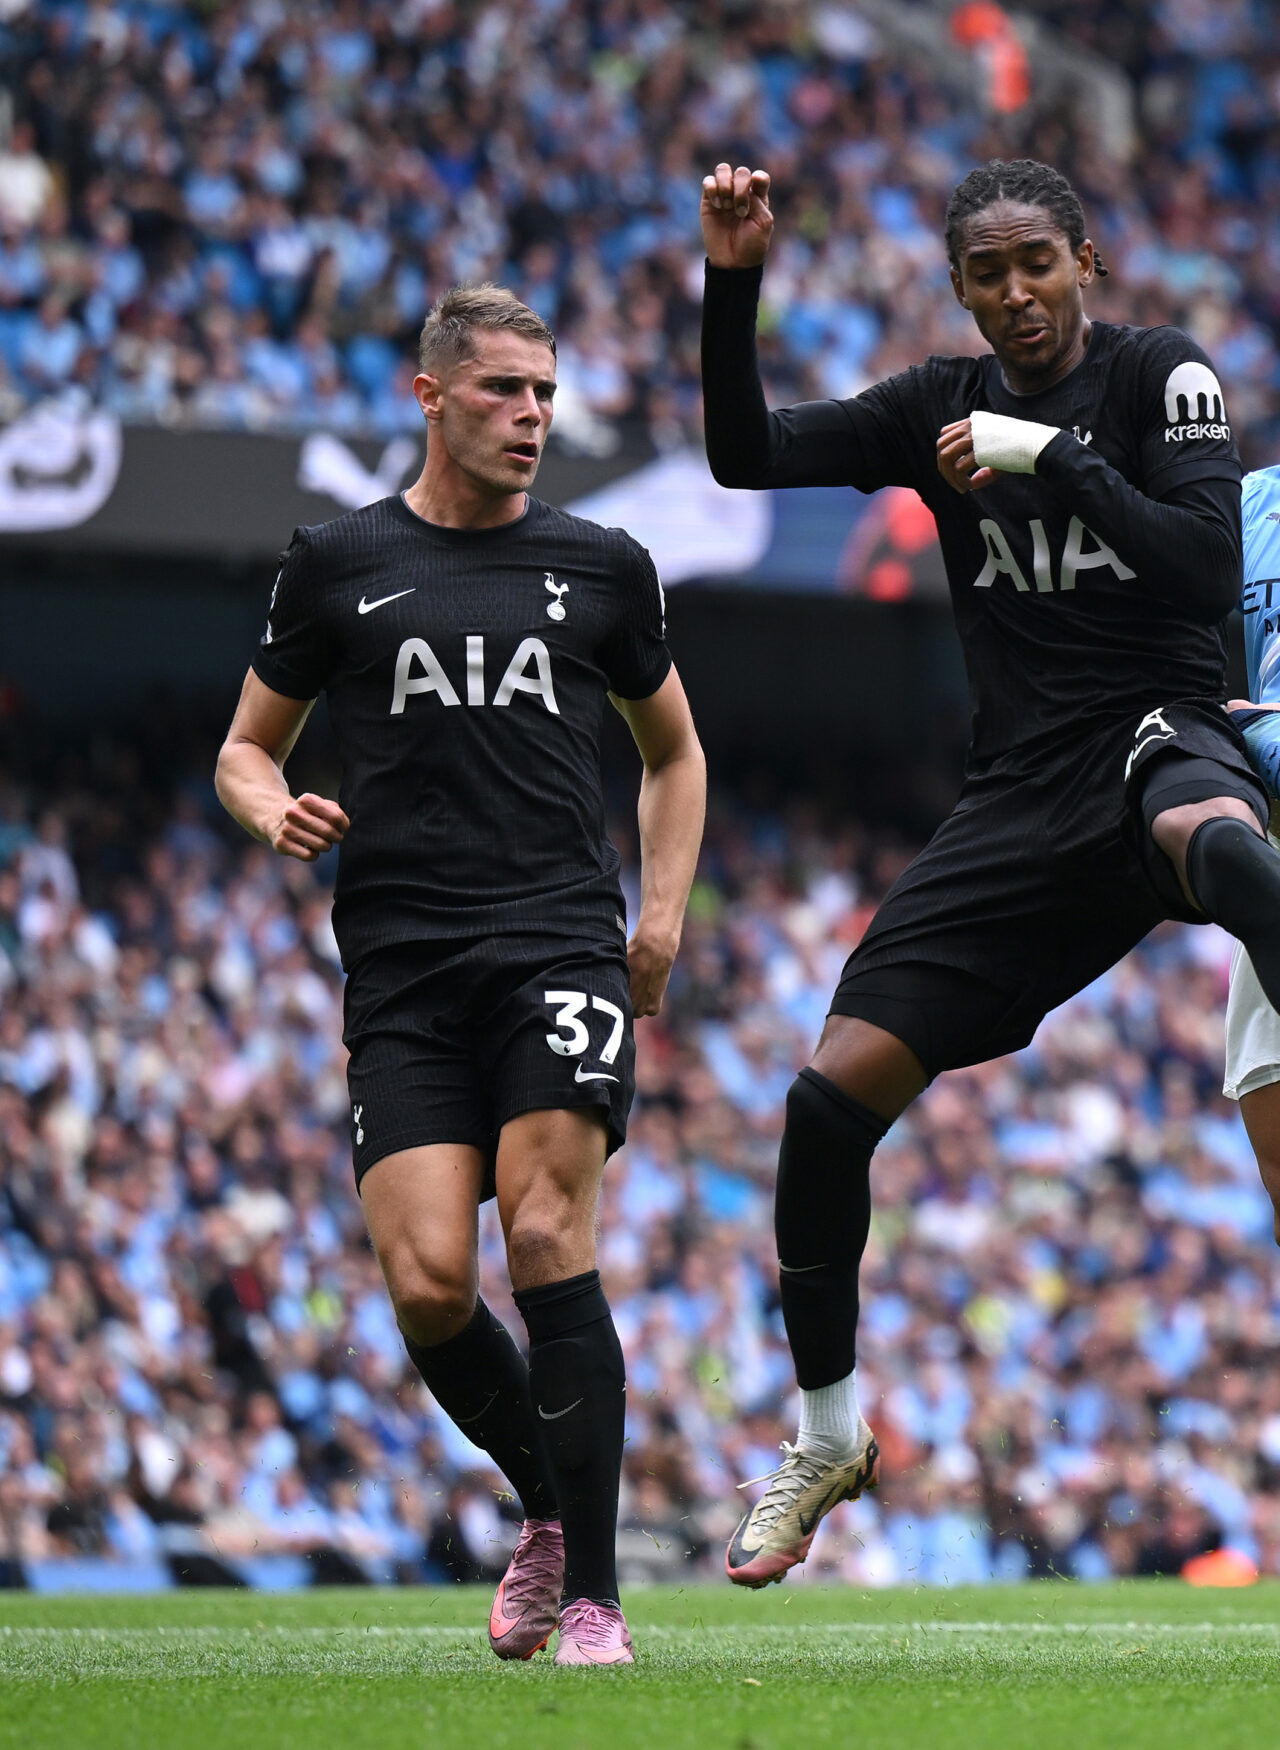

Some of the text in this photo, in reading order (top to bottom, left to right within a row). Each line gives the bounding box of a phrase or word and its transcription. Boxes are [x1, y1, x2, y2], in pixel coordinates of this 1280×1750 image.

[1164, 423, 1231, 443] kraken
[973, 514, 1138, 593] AIA
[390, 635, 561, 715] AIA
[545, 990, 624, 1065] 37
